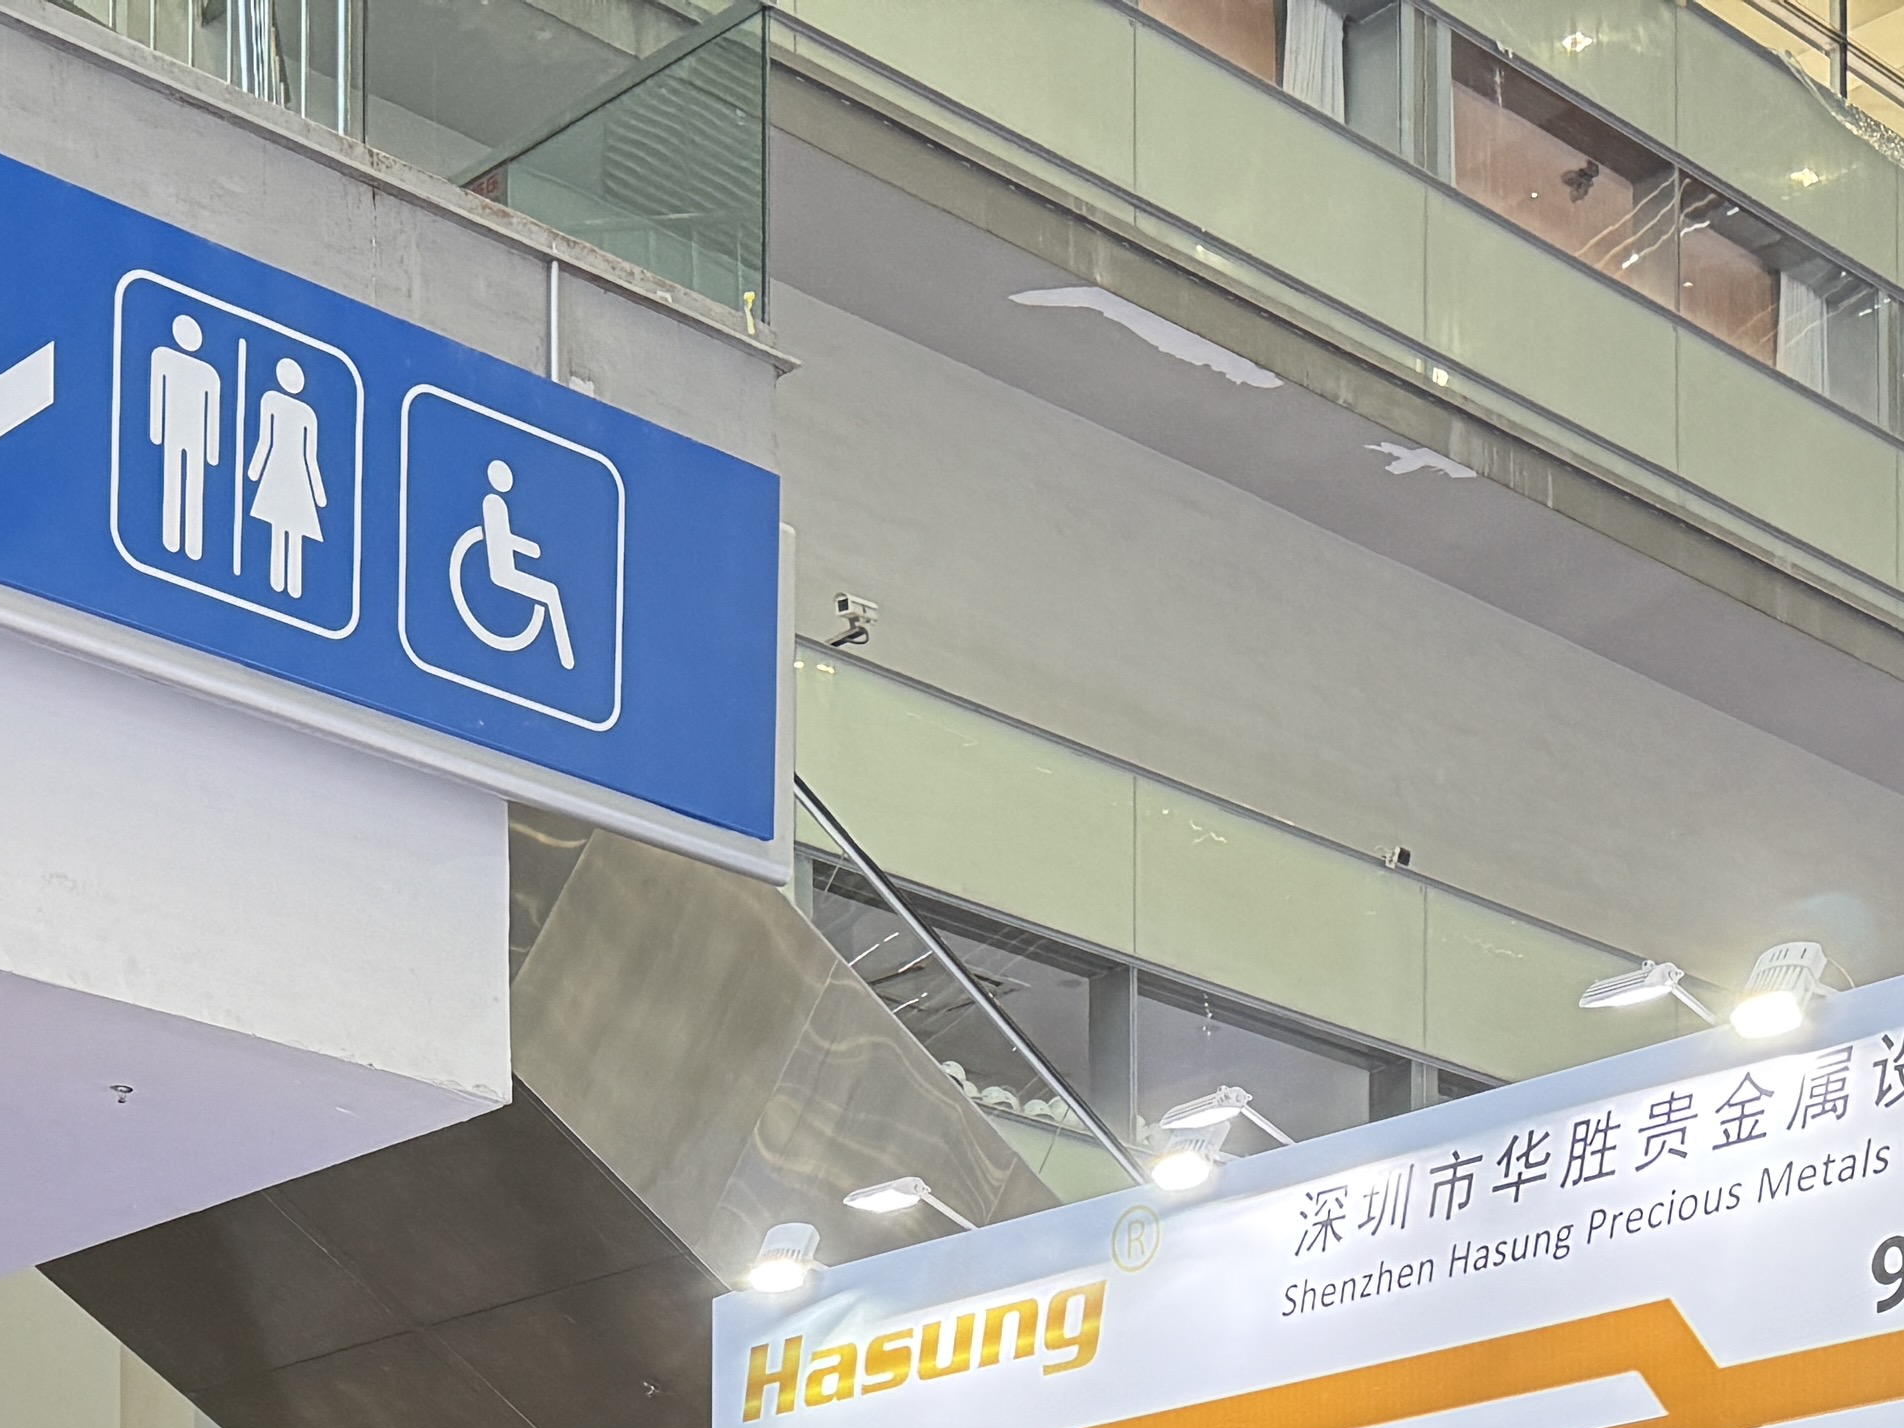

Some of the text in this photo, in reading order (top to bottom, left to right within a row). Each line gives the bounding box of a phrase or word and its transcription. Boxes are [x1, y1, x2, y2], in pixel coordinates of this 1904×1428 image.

[1282, 1254, 1435, 1318] Shenzhen
[1448, 1226, 1572, 1281] Hasung
[1586, 1184, 1742, 1247] Precious
[1757, 1138, 1890, 1206] Metals
[741, 1277, 1107, 1424] Hasung
